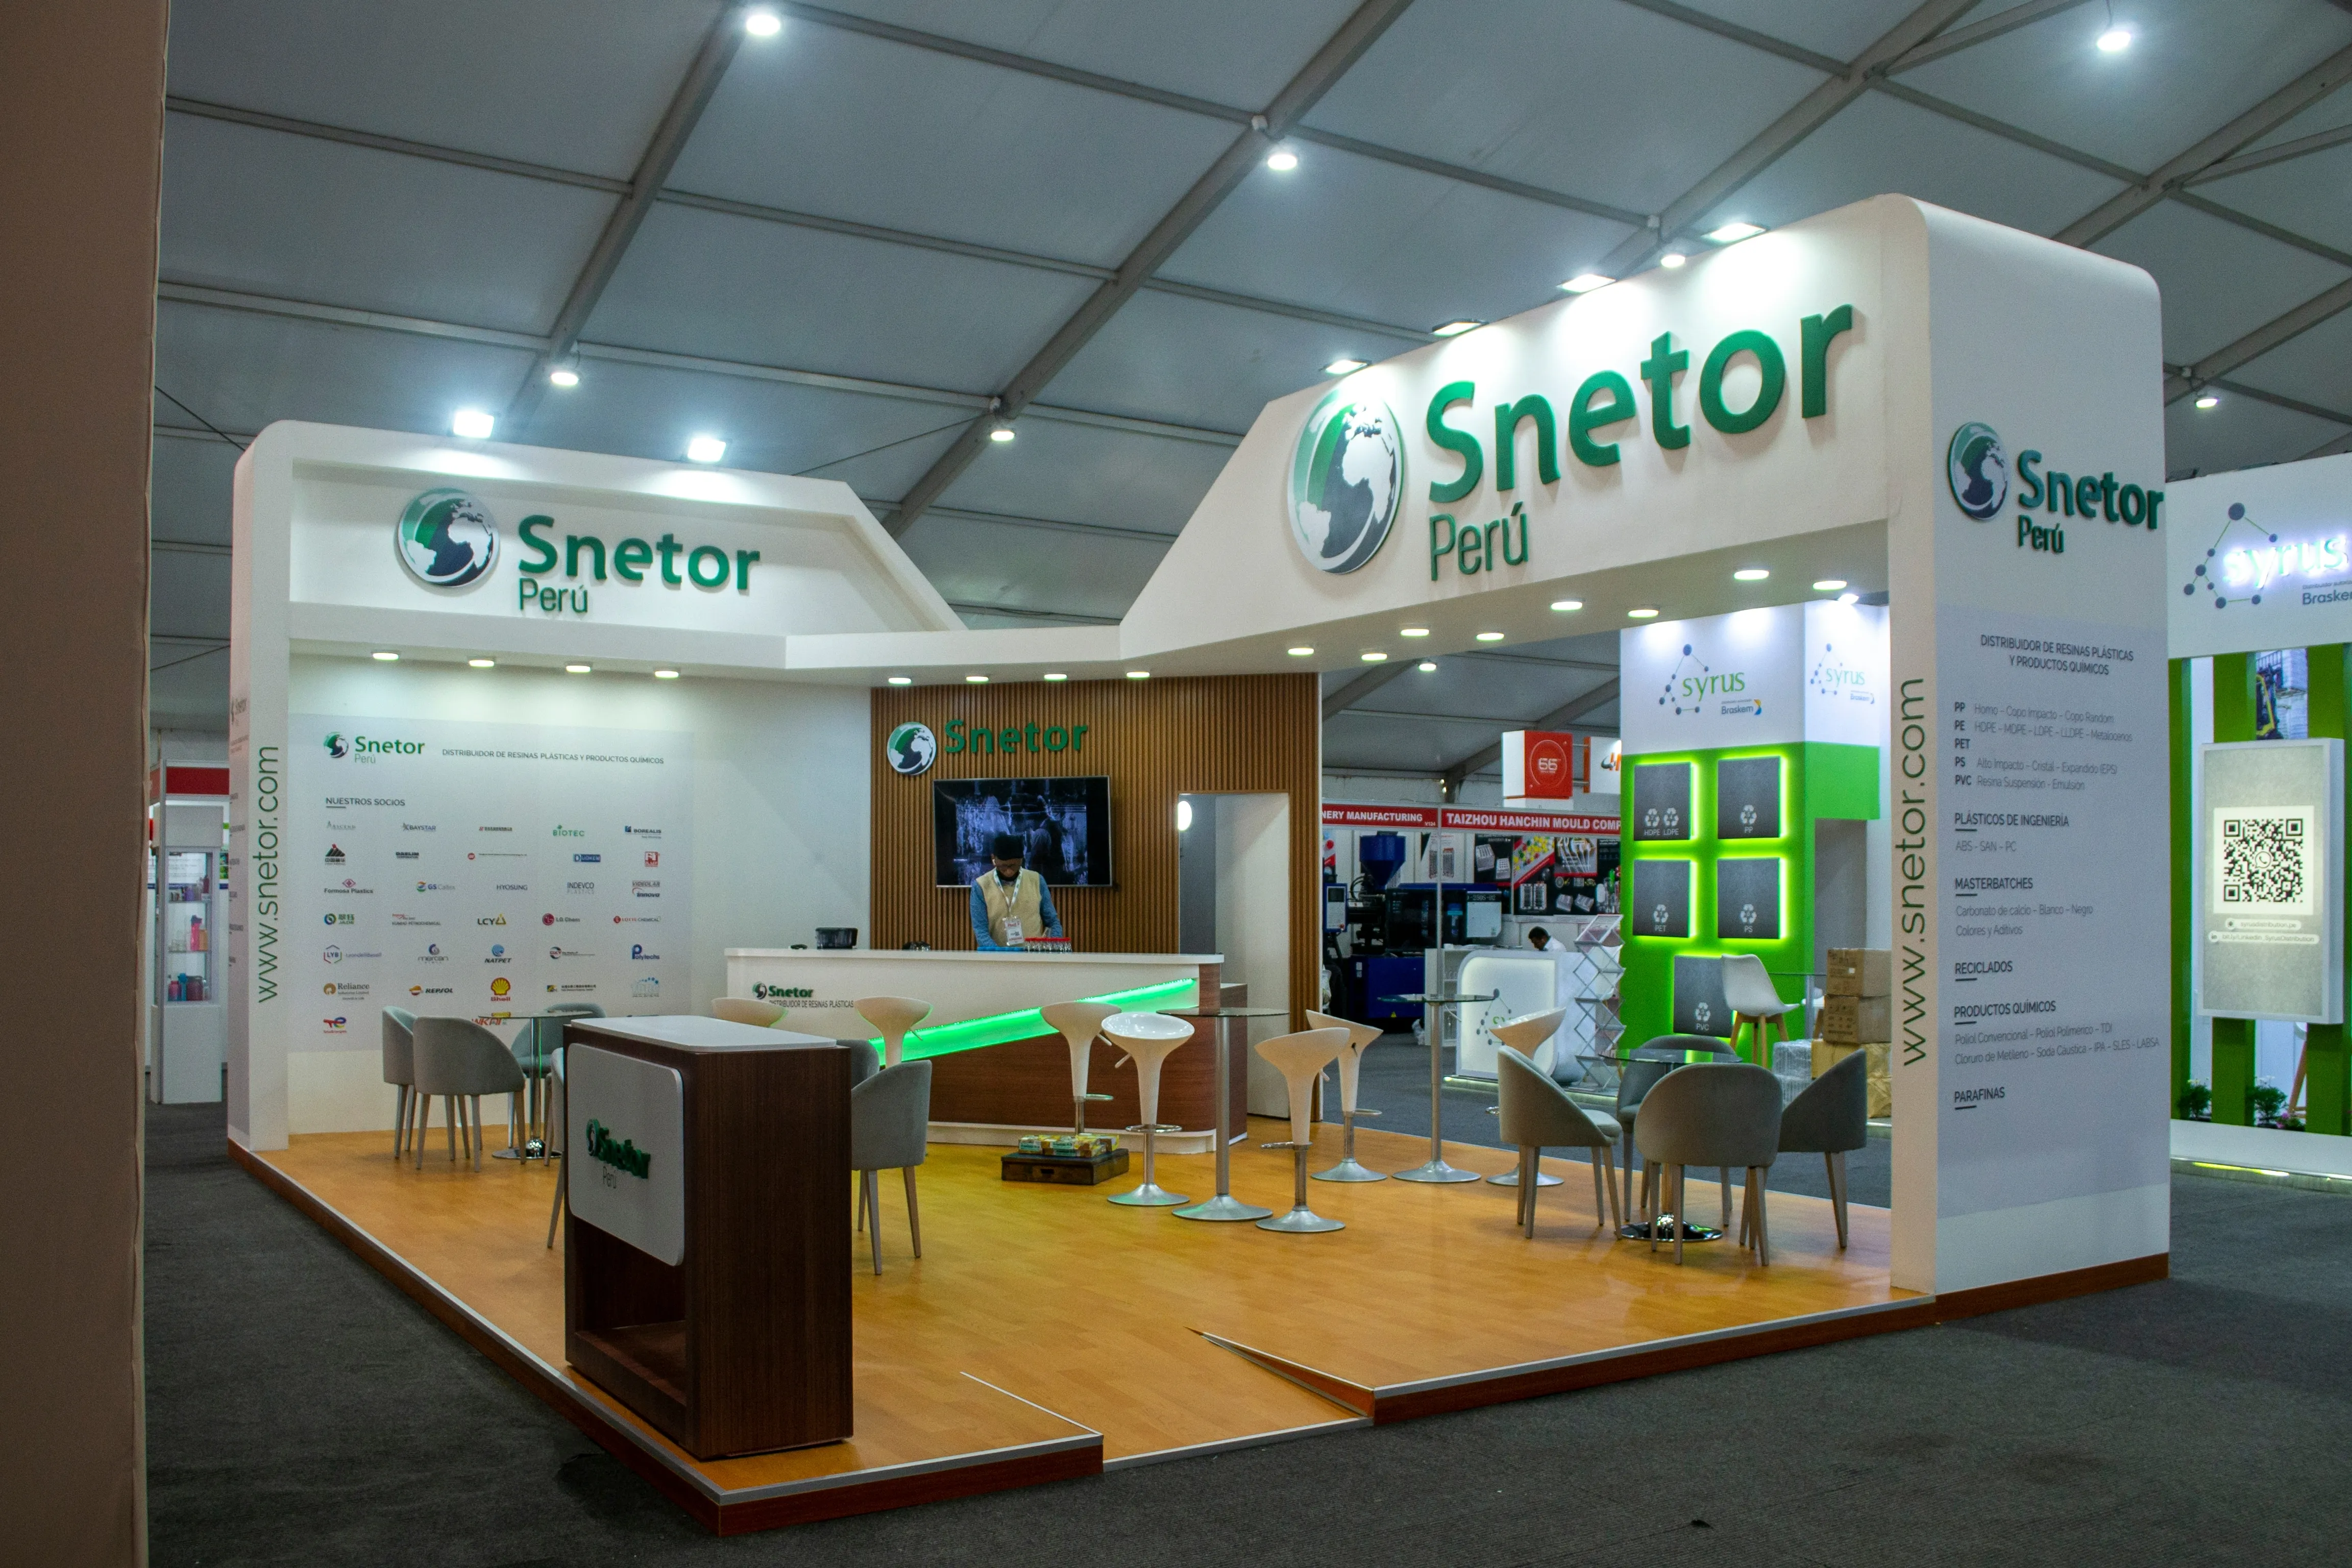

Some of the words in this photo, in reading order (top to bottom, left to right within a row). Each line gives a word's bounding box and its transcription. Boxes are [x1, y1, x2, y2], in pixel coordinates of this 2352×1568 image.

[1427, 304, 1852, 503] Snetor
[2018, 449, 2164, 530] Snetor
[1429, 501, 1528, 581] Perú
[2019, 514, 2064, 553] Perú
[518, 514, 761, 591] Snetor
[2223, 537, 2348, 588] syrus
[519, 577, 589, 614] Perú
[2302, 590, 2352, 605] Braske
[1981, 634, 2041, 651] DISTRIBUIDOR
[2043, 642, 2053, 653] DE
[2056, 643, 2090, 656] RESINAS
[2092, 645, 2134, 662] PLÁSTICAS
[2010, 655, 2016, 666] Y
[2017, 656, 2068, 671] PRODUCTOS
[2070, 660, 2109, 675] QUÍMICOS
[1826, 668, 1865, 688] syrus
[1682, 672, 1745, 701] syrus
[1721, 705, 1754, 714] Braskem
[1954, 702, 1966, 712] PP
[944, 719, 1087, 753] Snetor
[1954, 720, 1965, 730] PE
[1975, 721, 1996, 733] HDPE
[2034, 725, 2053, 737] LDPE
[355, 736, 426, 754] Snetor
[1954, 738, 1970, 749] PET
[355, 754, 376, 764] Perú
[443, 749, 494, 757] DISTRIBUIDOR
[541, 752, 578, 761] PLÁSTICAS
[630, 755, 664, 764] QUÍMICOS
[1955, 756, 1966, 767] PS
[1955, 775, 1972, 786] PVC
[326, 797, 372, 805] NUESTROS
[1347, 812, 1423, 822] MANUFACTURING
[1447, 813, 1497, 825] TAIZHOU
[1499, 816, 1550, 828] HANCHIN
[1553, 818, 1590, 829] MOULD
[1955, 811, 2004, 825] PLÁSTICOS
[2007, 814, 2019, 825] DE
[2021, 813, 2069, 826] INGENIERÍA
[1955, 841, 1972, 851] ABS
[1980, 841, 1997, 851] SAN
[2005, 841, 2017, 851] PC
[253, 746, 279, 1003] www.snetor.com
[1895, 678, 1926, 1066] www.snetor.com
[1955, 877, 2033, 889] MASTERBATCHES
[1956, 905, 1996, 916] Carbonato
[1998, 905, 2007, 915] de
[2039, 904, 2064, 915] Blanco
[1956, 925, 1986, 936] Colores
[1994, 924, 2023, 935] Aditivos
[1955, 961, 2013, 974] RECICLADOS
[768, 985, 814, 997] Snetor
[1954, 1003, 2011, 1017] PRODUCTOS
[2013, 999, 2056, 1014] QUÍMICOS
[1985, 1051, 1995, 1062] de
[2037, 1046, 2055, 1058] Soda
[2113, 1039, 2130, 1050] SLES
[1954, 1087, 2005, 1102] PARAFINAS
